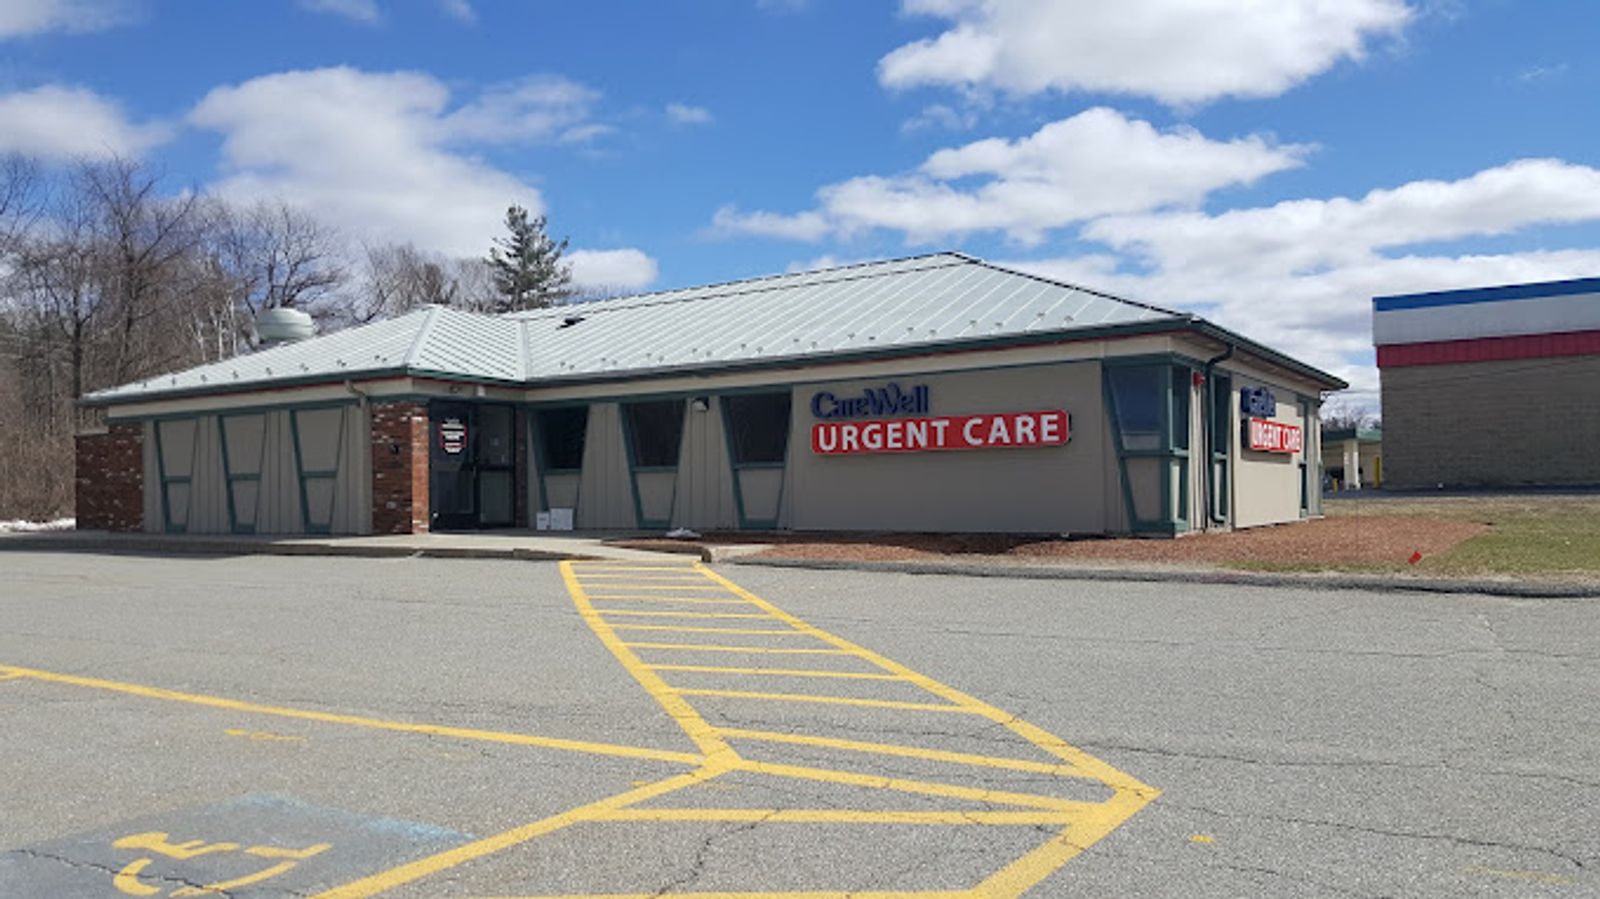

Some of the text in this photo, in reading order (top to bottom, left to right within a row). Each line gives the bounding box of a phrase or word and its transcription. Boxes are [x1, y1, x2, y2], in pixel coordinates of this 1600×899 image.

[811, 383, 930, 418] CareWell
[817, 414, 1061, 451] URGENT CARE
